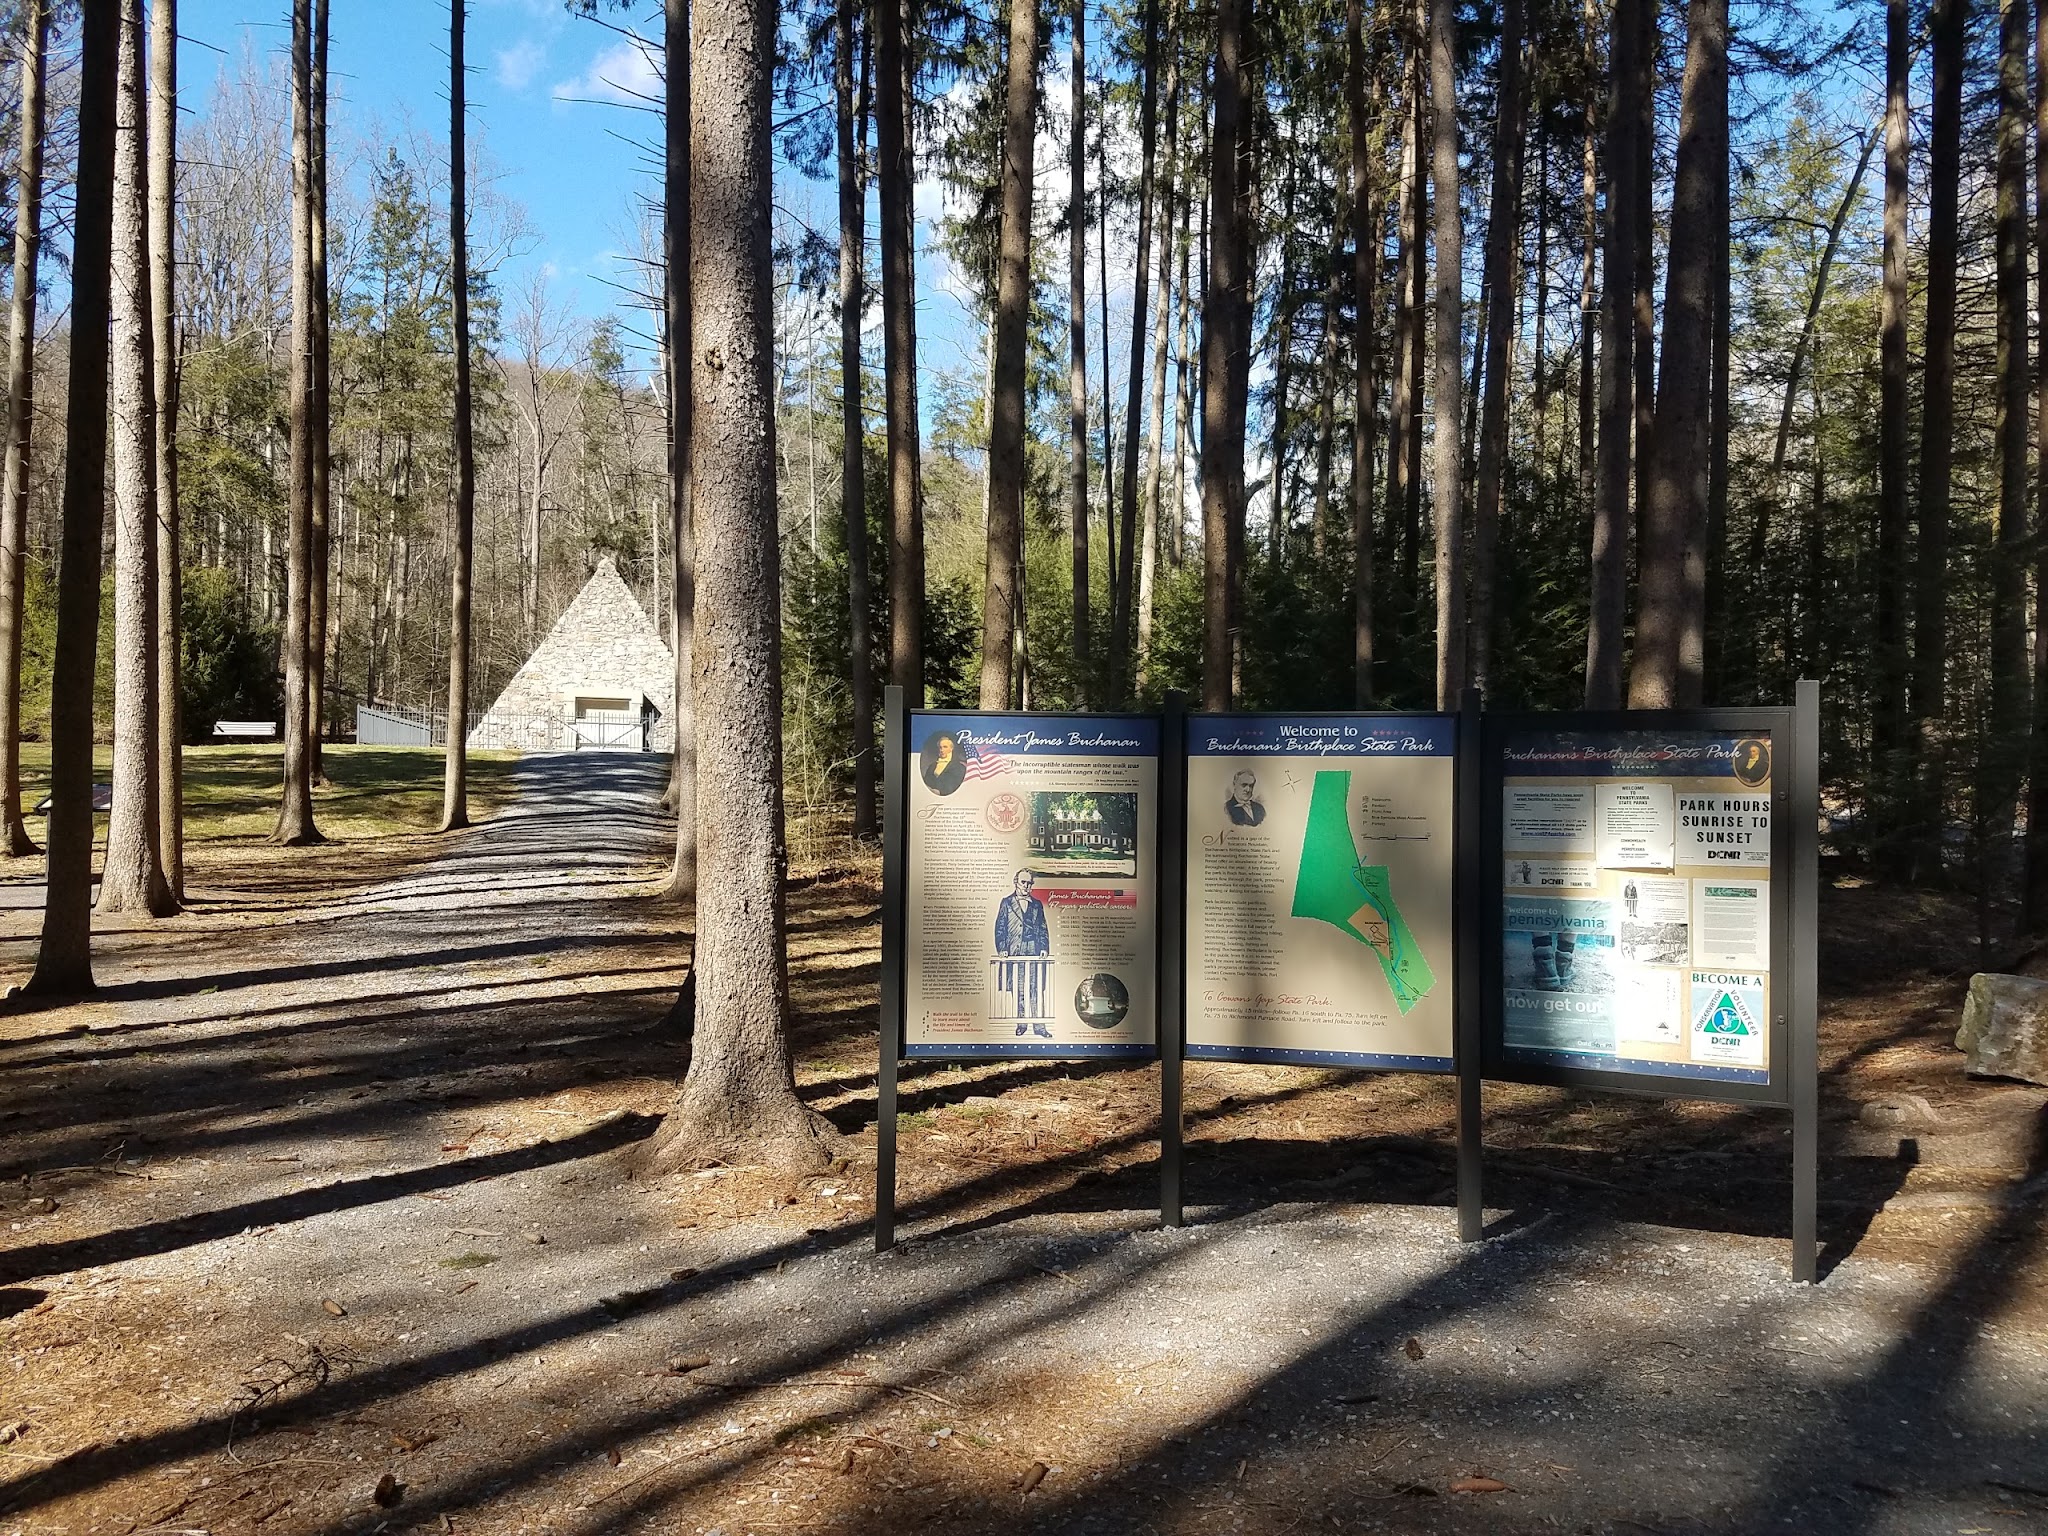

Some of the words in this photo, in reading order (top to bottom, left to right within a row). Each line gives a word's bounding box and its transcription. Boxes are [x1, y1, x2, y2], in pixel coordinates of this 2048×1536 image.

[1280, 725, 1340, 737] Welcome
[1344, 726, 1357, 737] to
[956, 729, 1021, 745] President
[1021, 731, 1064, 751] James
[1068, 732, 1141, 747] Buchanan
[1206, 737, 1282, 751] Buchanan's
[1285, 737, 1356, 756] Birthplace
[1360, 738, 1397, 752] State
[1400, 738, 1434, 752] Park
[1504, 745, 1579, 760] Buchanan's
[1581, 745, 1658, 763] Birthplace
[1663, 745, 1700, 759] State
[1704, 745, 1742, 759] Park
[1680, 800, 1715, 811] PARK
[1724, 801, 1770, 811] HOURS
[1682, 816, 1743, 827] SUNRISE
[1751, 817, 1767, 828] TO
[1697, 832, 1752, 843] SUNSET
[1708, 851, 1740, 859] DCNR
[1048, 891, 1068, 901] James
[1071, 891, 1111, 899] Buchanan's
[1078, 902, 1108, 912] political
[1508, 914, 1605, 930] pennsylvania
[1692, 973, 1748, 986] BECOME
[1753, 977, 1762, 986] A
[1203, 991, 1213, 1001] To
[1255, 993, 1274, 1007] Gap
[1278, 994, 1303, 1005] State
[1306, 995, 1332, 1005] Park:
[1506, 996, 1539, 1009] now
[1544, 998, 1572, 1013] get
[1695, 988, 1723, 1032] CONSERVATION
[1731, 989, 1758, 1036] VOLUNTEER
